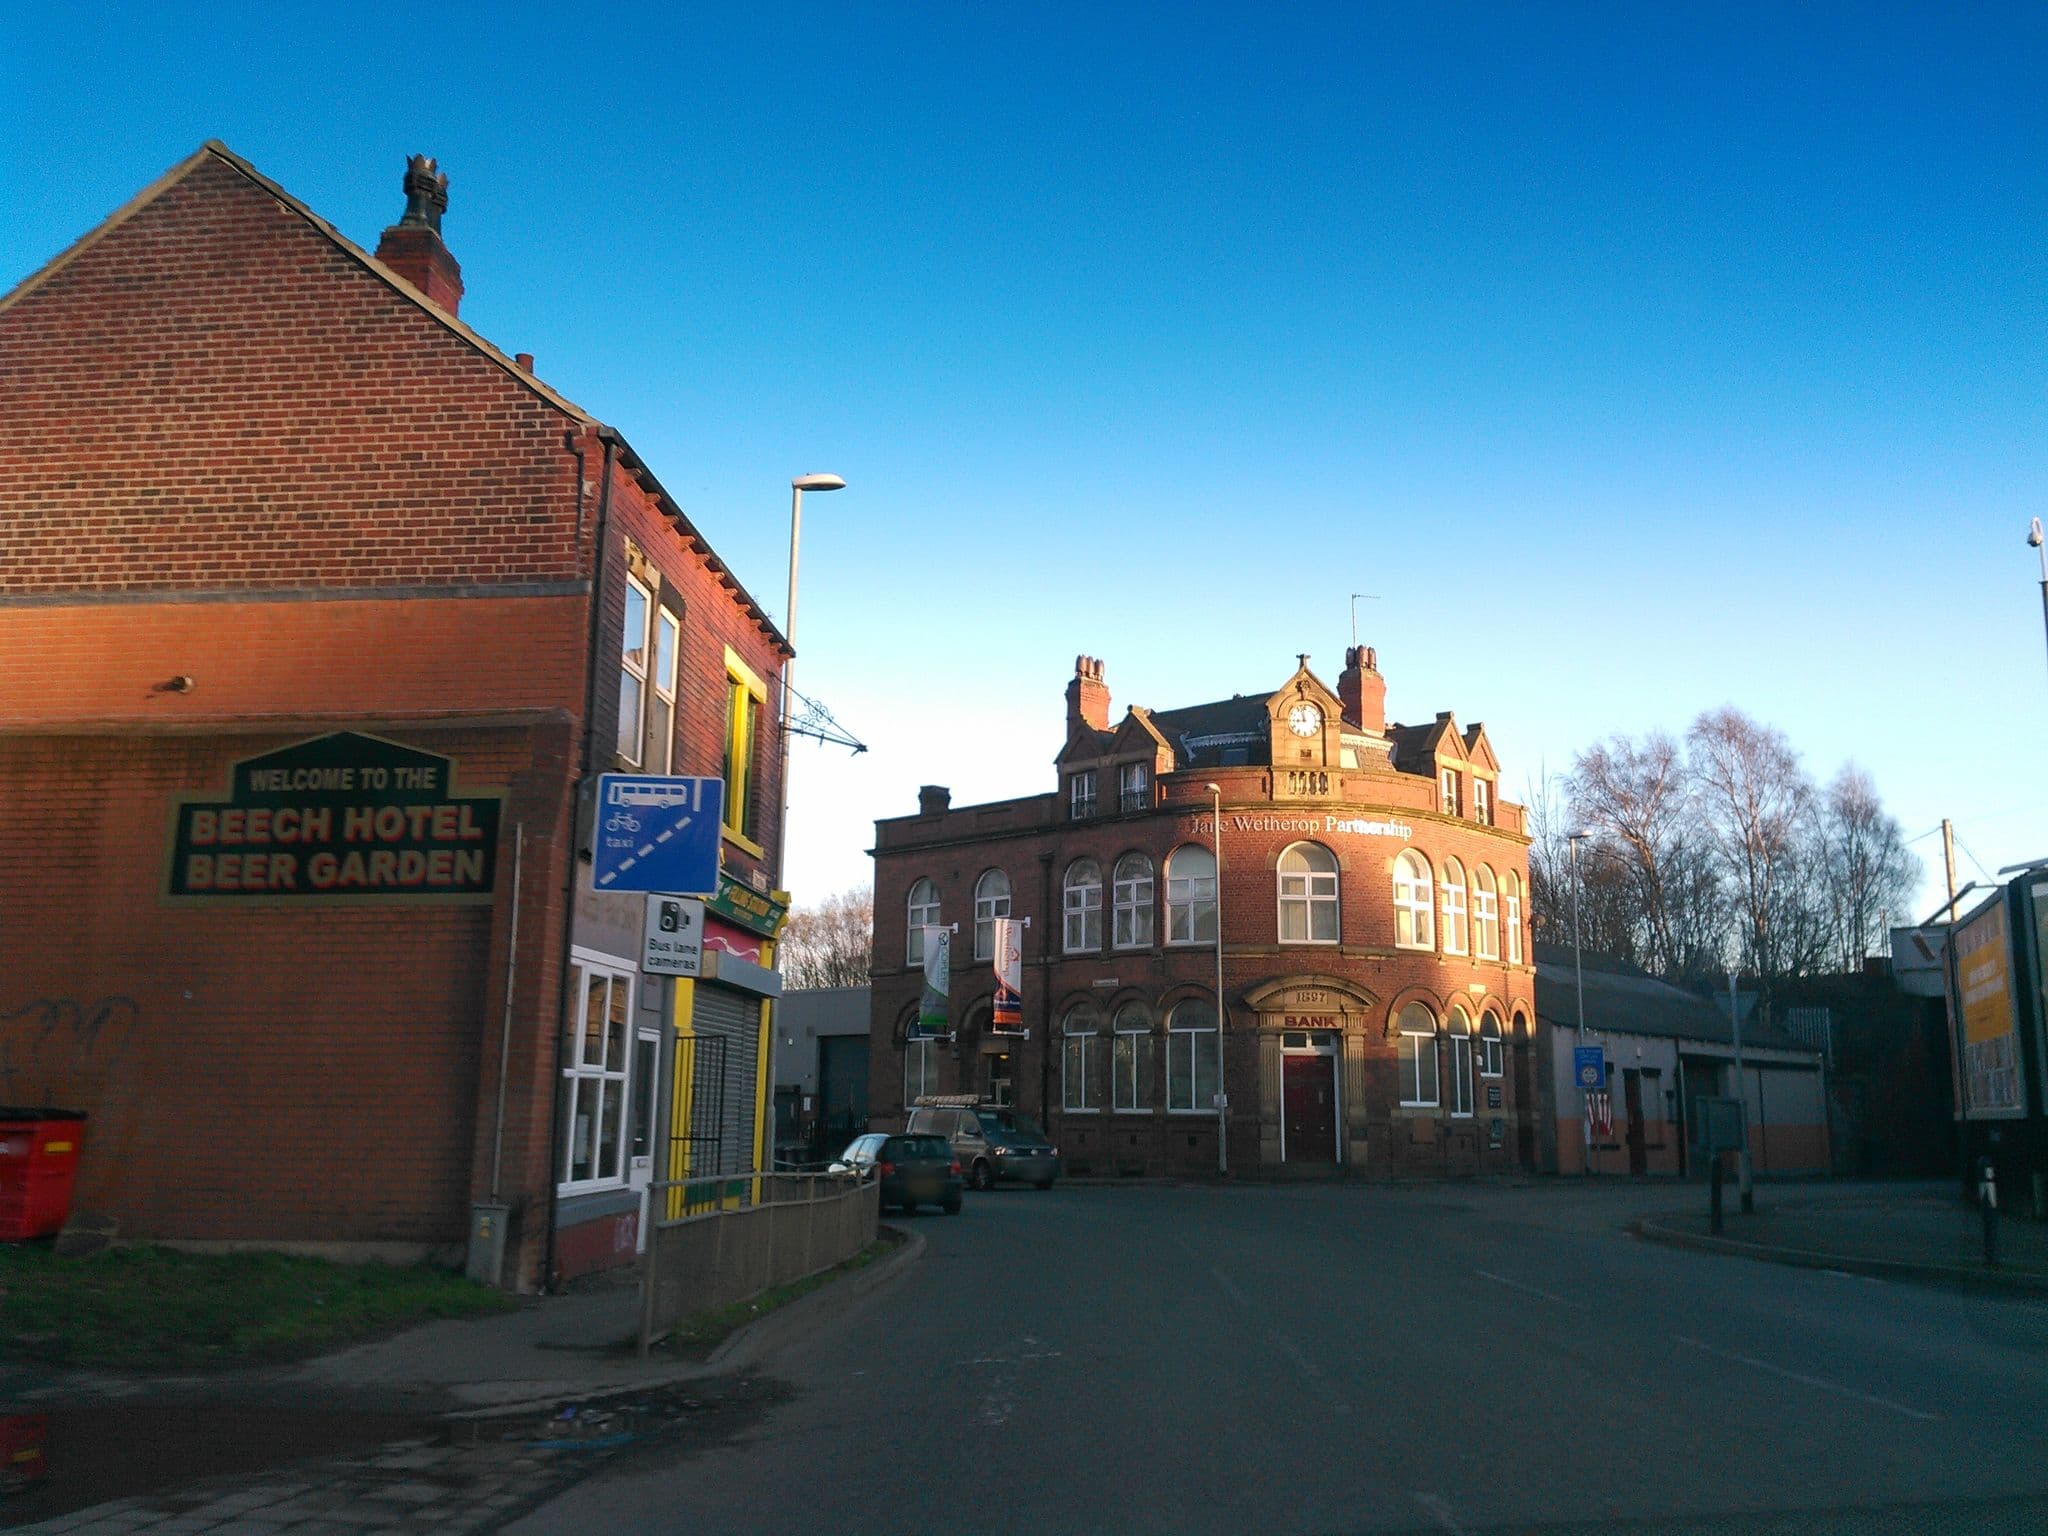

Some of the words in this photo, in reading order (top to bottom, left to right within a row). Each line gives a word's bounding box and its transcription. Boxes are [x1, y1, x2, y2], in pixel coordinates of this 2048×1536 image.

[250, 768, 353, 791] WELCOME
[359, 767, 388, 790] TO
[394, 767, 437, 789] THE
[190, 807, 331, 845] BEECH
[343, 805, 483, 842] HOTEL
[1232, 815, 1320, 836] Wetherop
[1325, 815, 1412, 841] Partnership
[186, 853, 298, 889] BEER
[306, 850, 483, 887] GARDEN
[649, 937, 671, 952] Bus
[673, 941, 698, 955] lane
[648, 956, 696, 970] cameras
[1284, 1015, 1338, 1028] BANK
